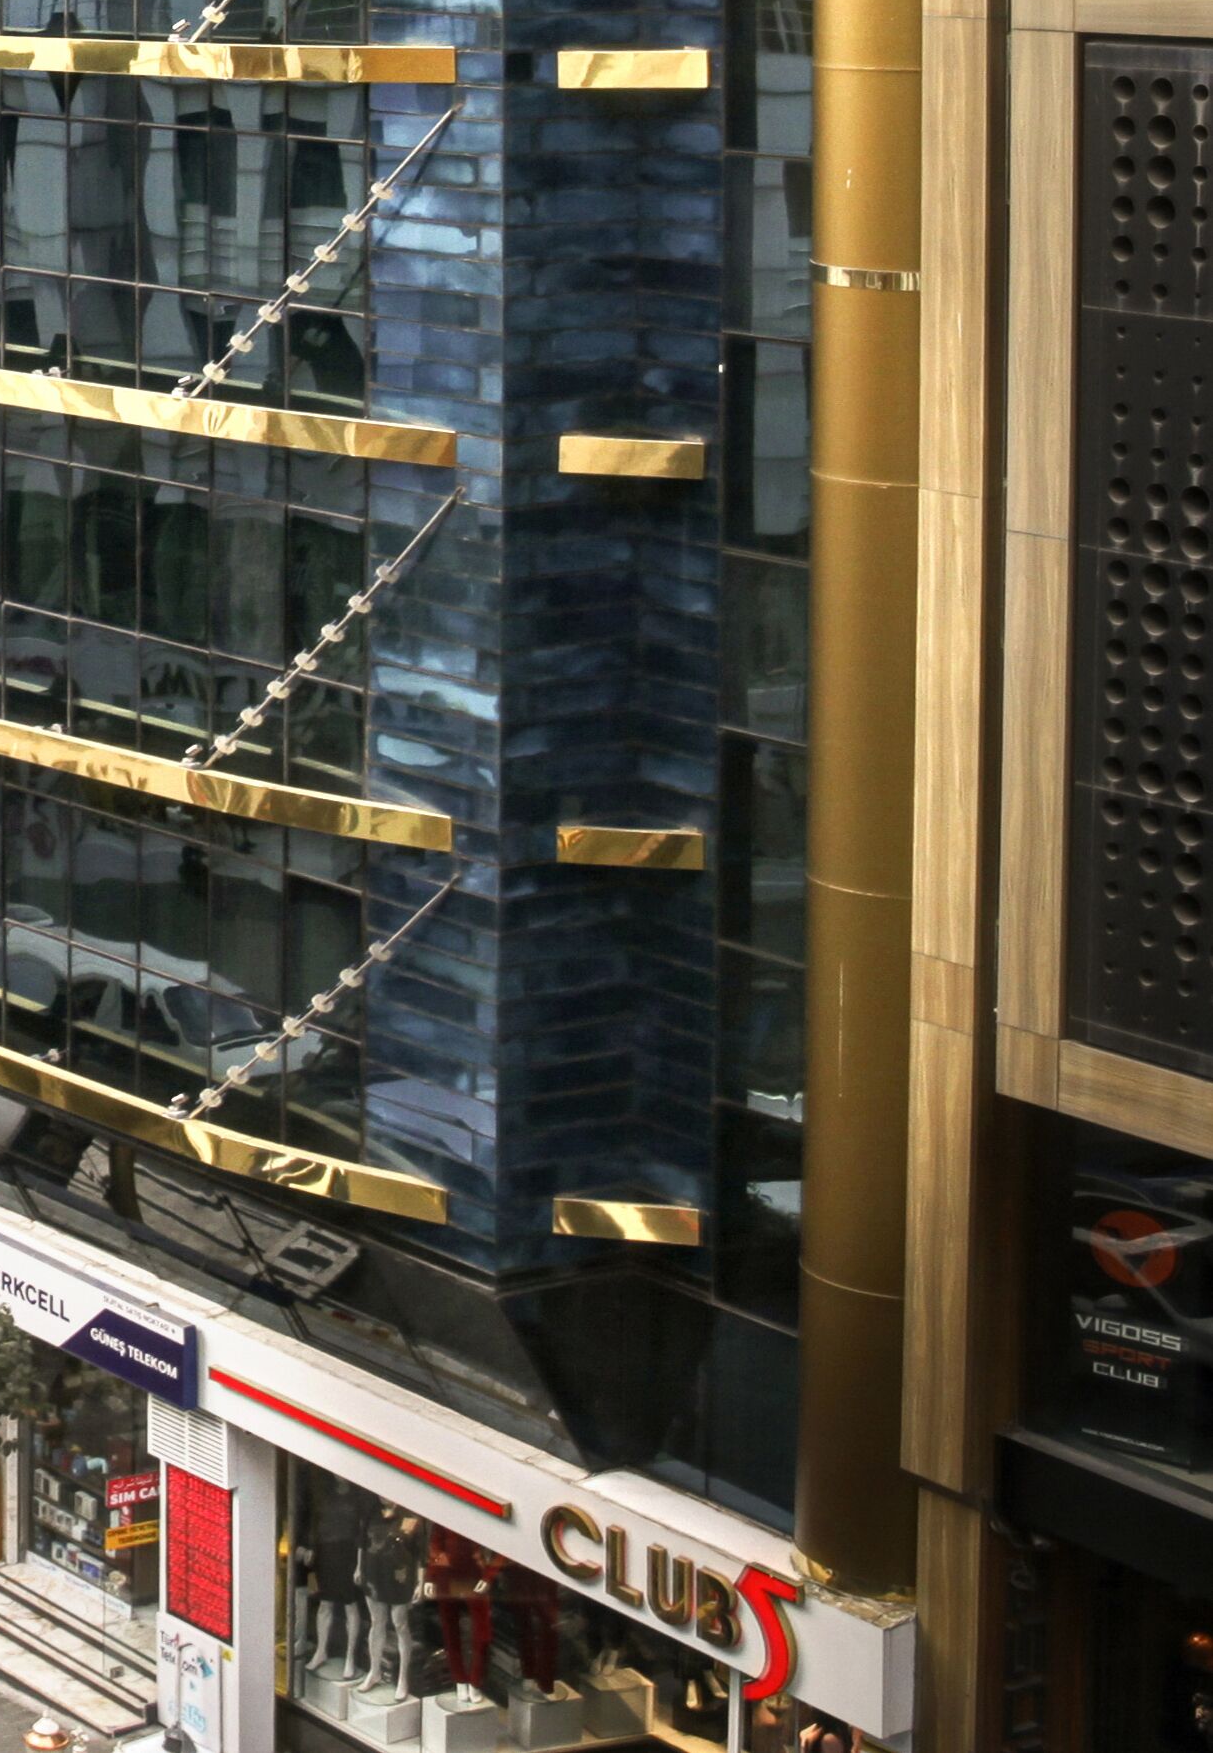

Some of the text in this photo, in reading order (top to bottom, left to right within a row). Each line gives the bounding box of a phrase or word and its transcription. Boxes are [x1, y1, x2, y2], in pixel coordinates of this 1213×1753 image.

[1075, 1312, 1182, 1352] VIGOSS
[90, 1327, 178, 1380] GÜNEŞ TELEKOM
[1082, 1339, 1172, 1371] SPORT
[1093, 1361, 1160, 1388] CLUB
[109, 1486, 159, 1506] SIM CA
